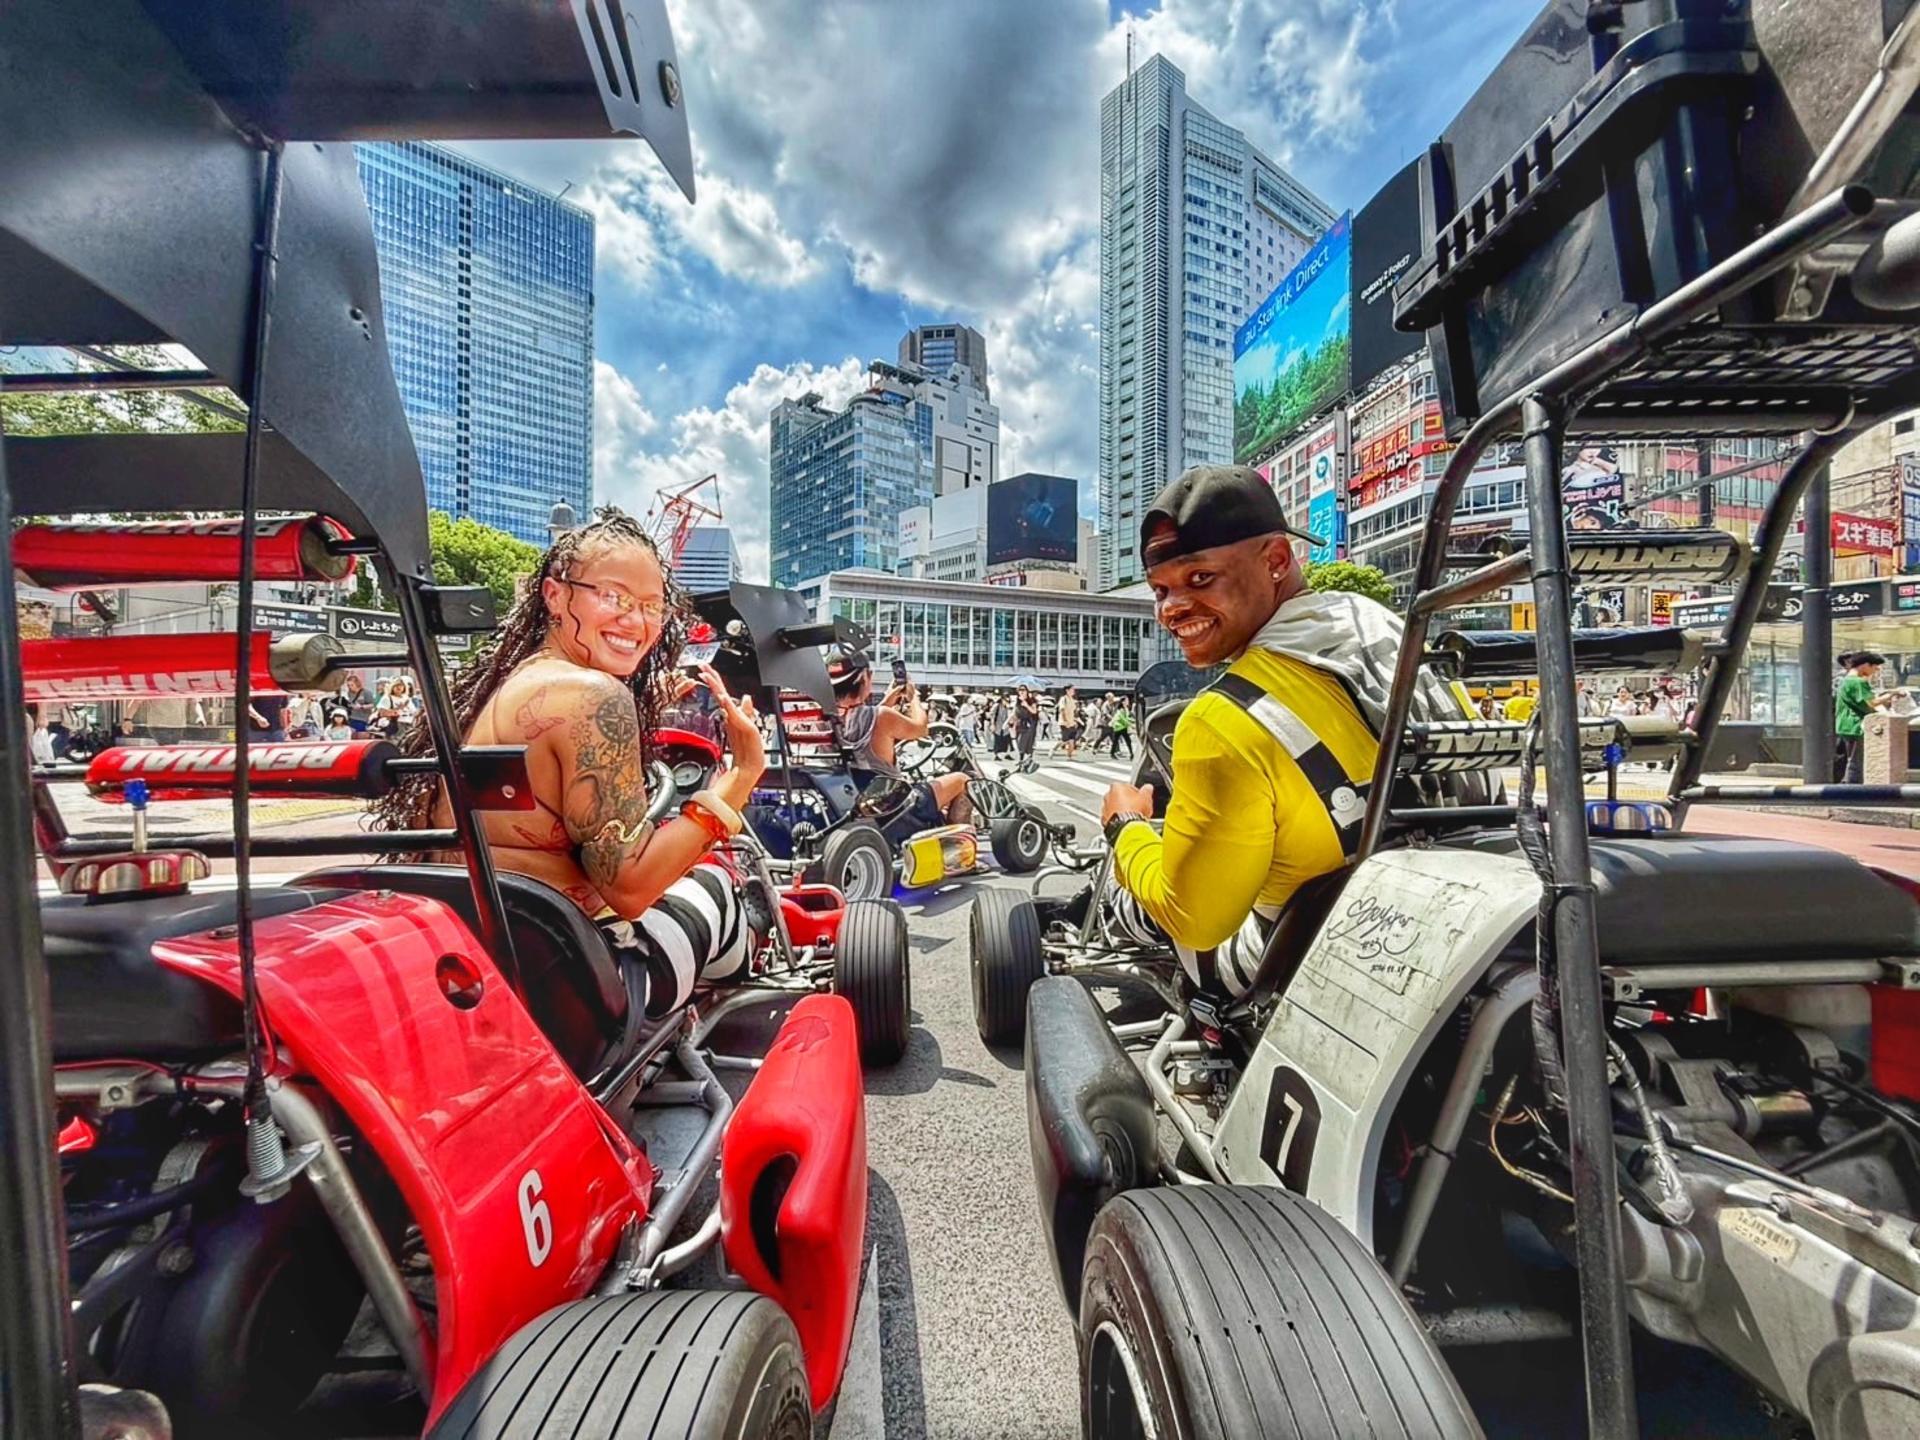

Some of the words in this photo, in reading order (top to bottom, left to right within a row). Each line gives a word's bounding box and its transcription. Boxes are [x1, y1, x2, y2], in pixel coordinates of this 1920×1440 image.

[1244, 327, 1257, 345] au
[1257, 283, 1293, 331] Starlink
[1295, 244, 1330, 292] Direct
[1386, 450, 1411, 473] ガスト
[1836, 519, 1894, 549] スギ薬局
[1568, 546, 1731, 570] RENTHA
[361, 619, 402, 632] しぶちか
[120, 749, 343, 772] RENTHAL
[1276, 1091, 1303, 1176] 7
[518, 1168, 552, 1268] 6
